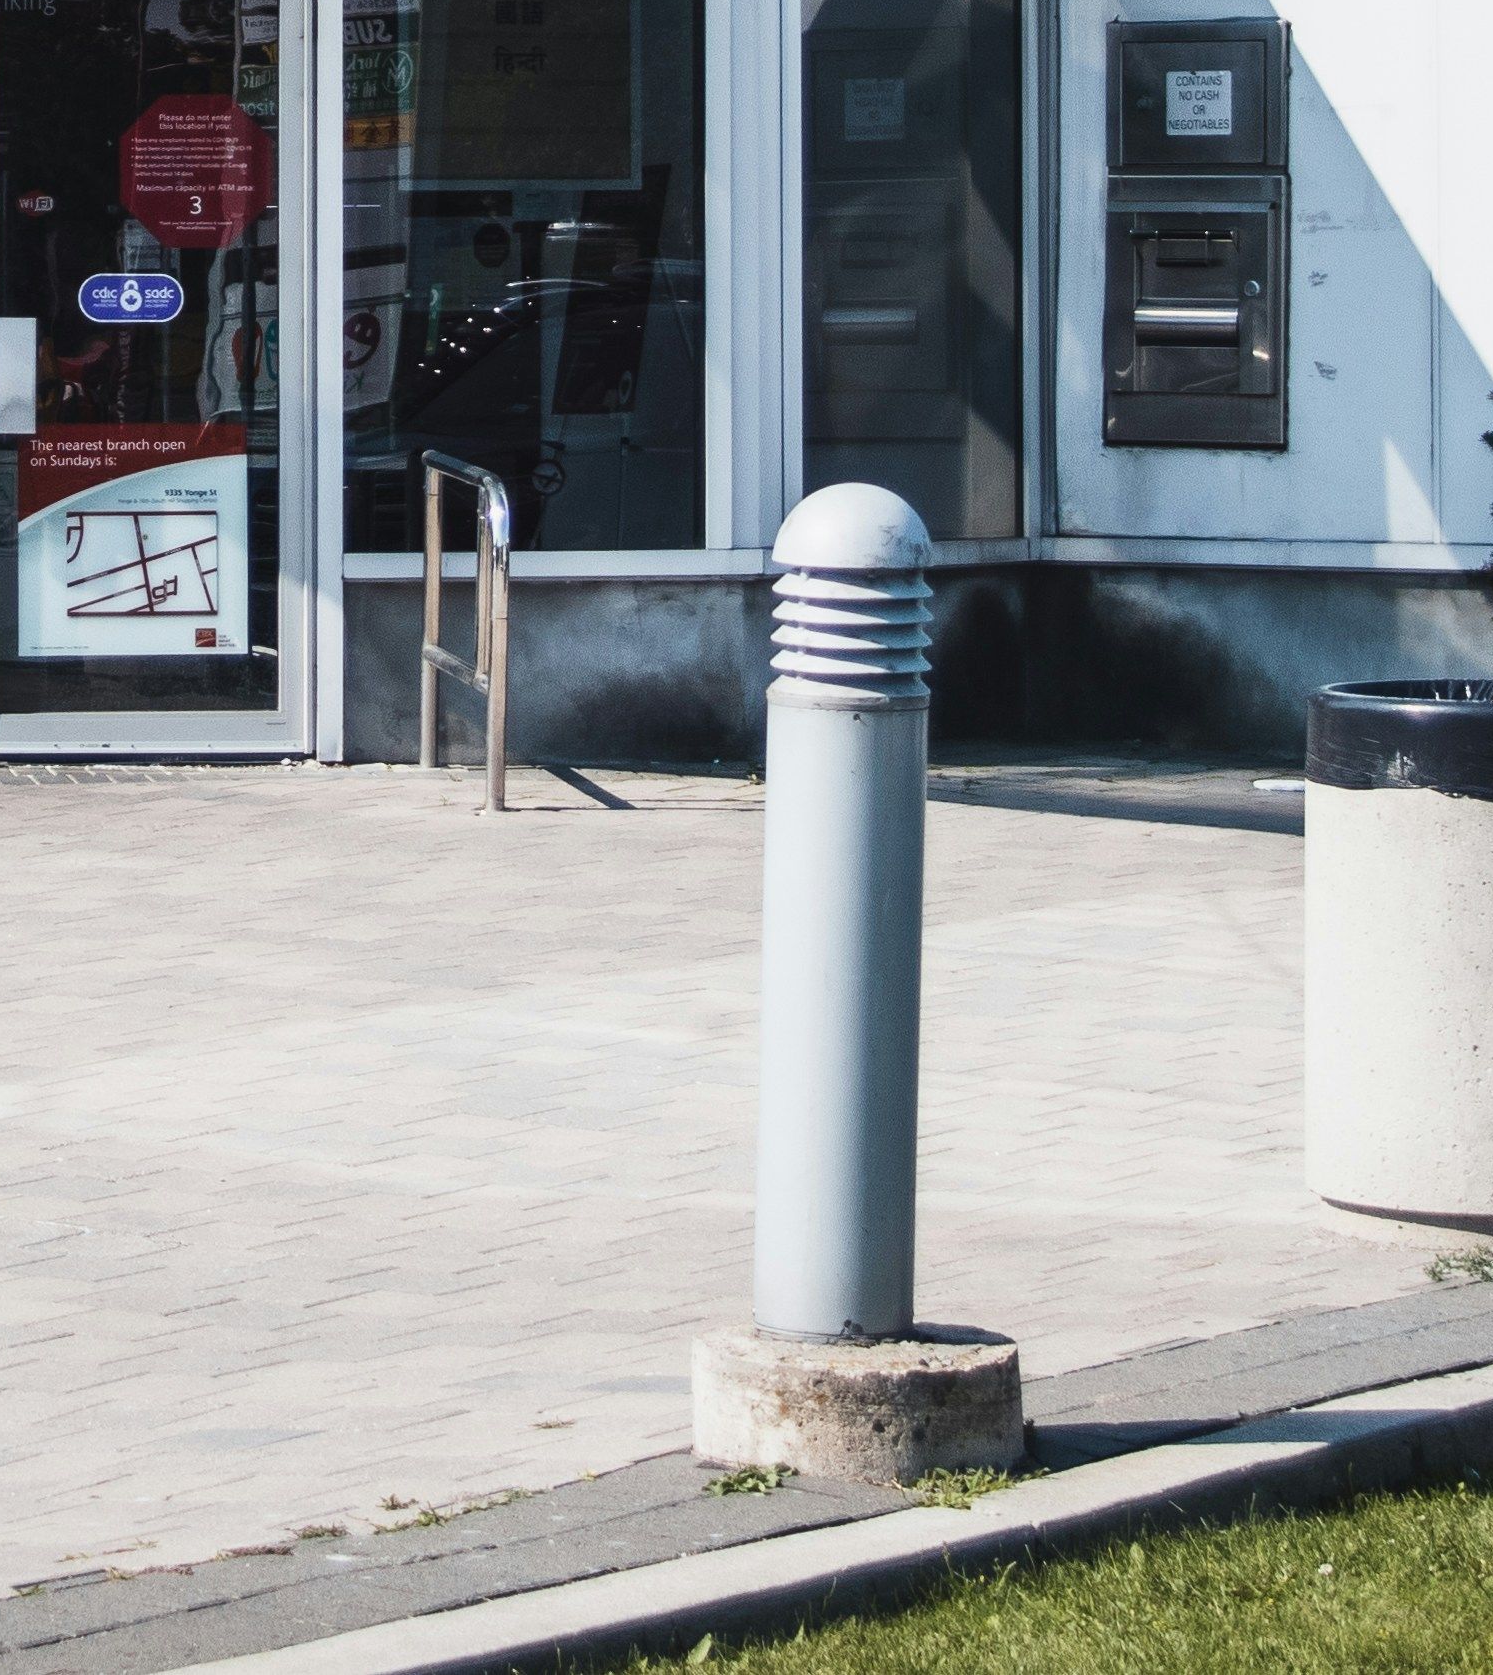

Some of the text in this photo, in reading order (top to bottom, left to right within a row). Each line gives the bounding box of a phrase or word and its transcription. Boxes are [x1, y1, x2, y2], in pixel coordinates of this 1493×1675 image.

[1175, 75, 1223, 88] CONTAINS
[1178, 90, 1220, 102] NO CASH
[1192, 104, 1206, 116] OR
[158, 113, 232, 122] Please do not enter
[159, 122, 174, 130] this
[175, 122, 206, 130] location
[1168, 118, 1230, 131] NEGOTIABLES
[136, 184, 174, 192] Maximum
[175, 184, 207, 193] capacity
[208, 184, 215, 192] in
[217, 184, 236, 192] ATM
[189, 195, 203, 216] 3
[92, 286, 175, 299] cdic sadc
[30, 439, 186, 456] The nearest branch open
[30, 455, 118, 470] on Sundays is:
[165, 489, 218, 499] 9335 Yonge St
